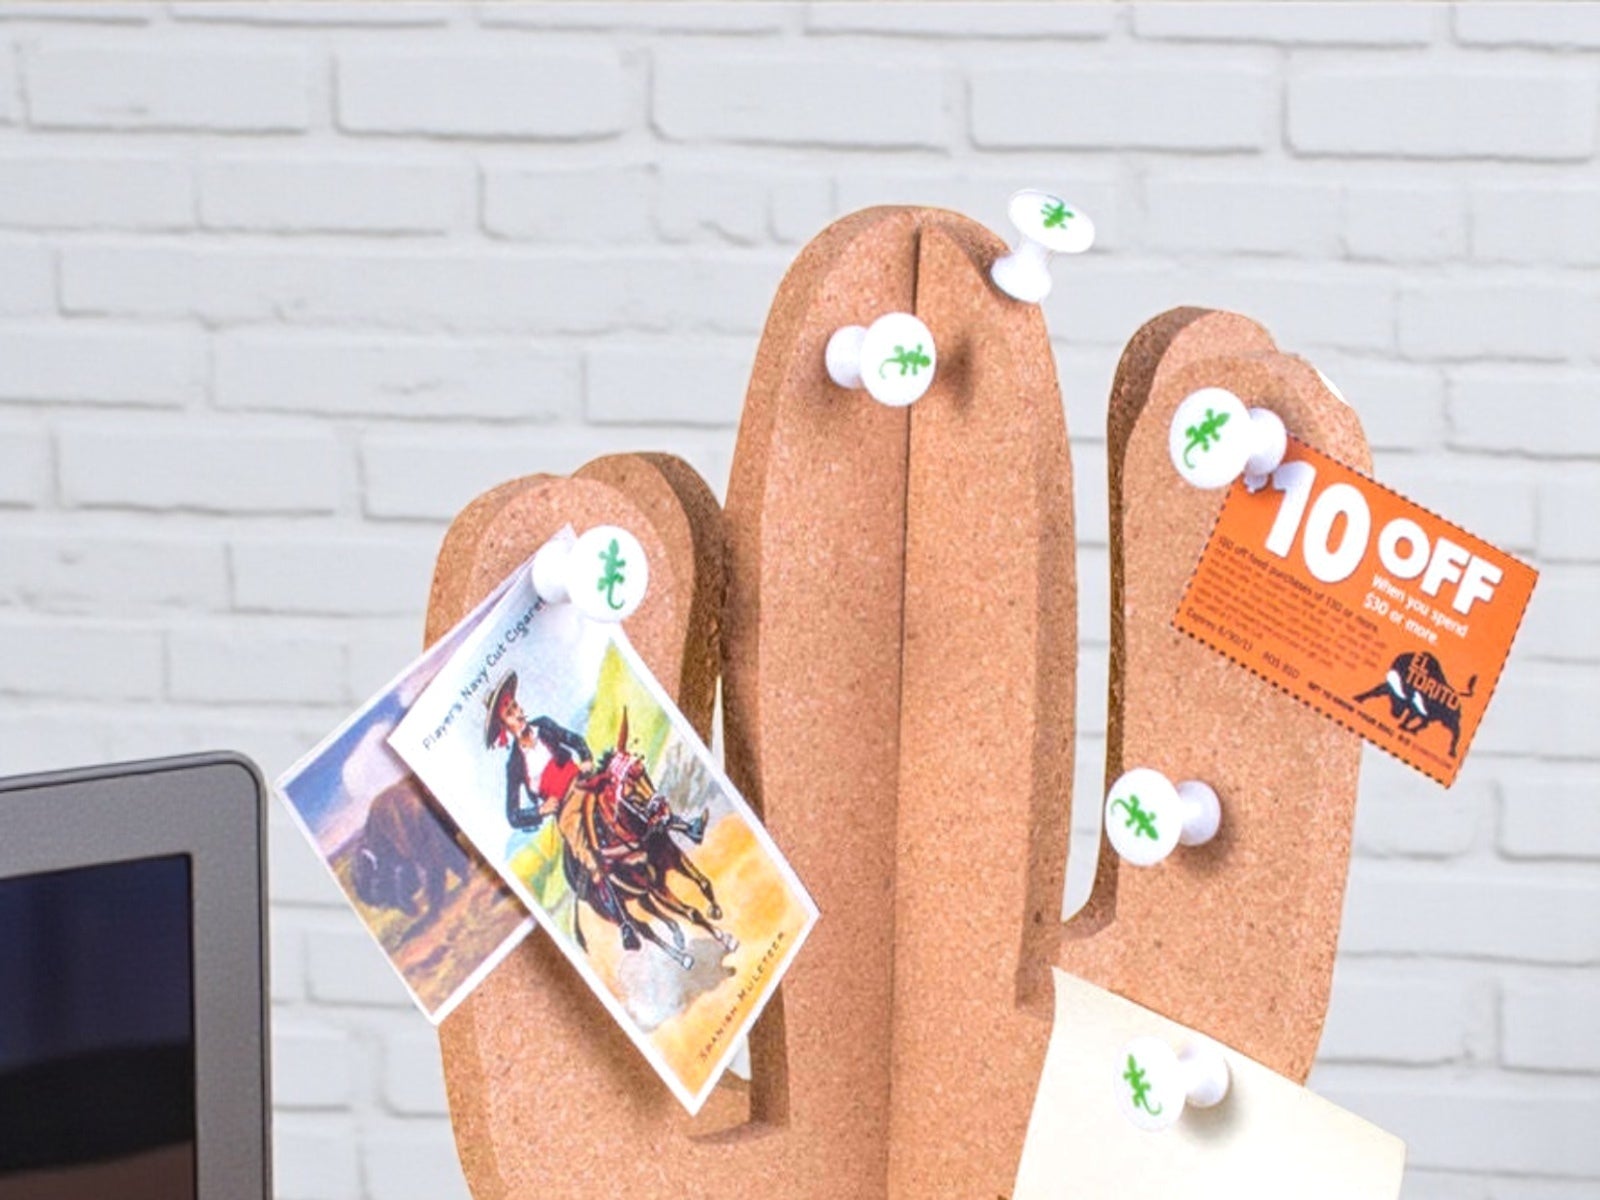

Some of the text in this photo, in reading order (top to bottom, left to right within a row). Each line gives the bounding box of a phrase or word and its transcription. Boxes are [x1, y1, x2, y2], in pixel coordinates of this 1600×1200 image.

[1264, 460, 1371, 583] 10
[1377, 517, 1502, 615] OFF
[1363, 591, 1389, 616] $30
[1388, 610, 1404, 625] or
[1371, 574, 1469, 639] When you spend
[460, 664, 490, 699] Navy
[486, 642, 507, 668] Cut
[1407, 666, 1460, 711] TORITO
[1410, 654, 1428, 674] EL
